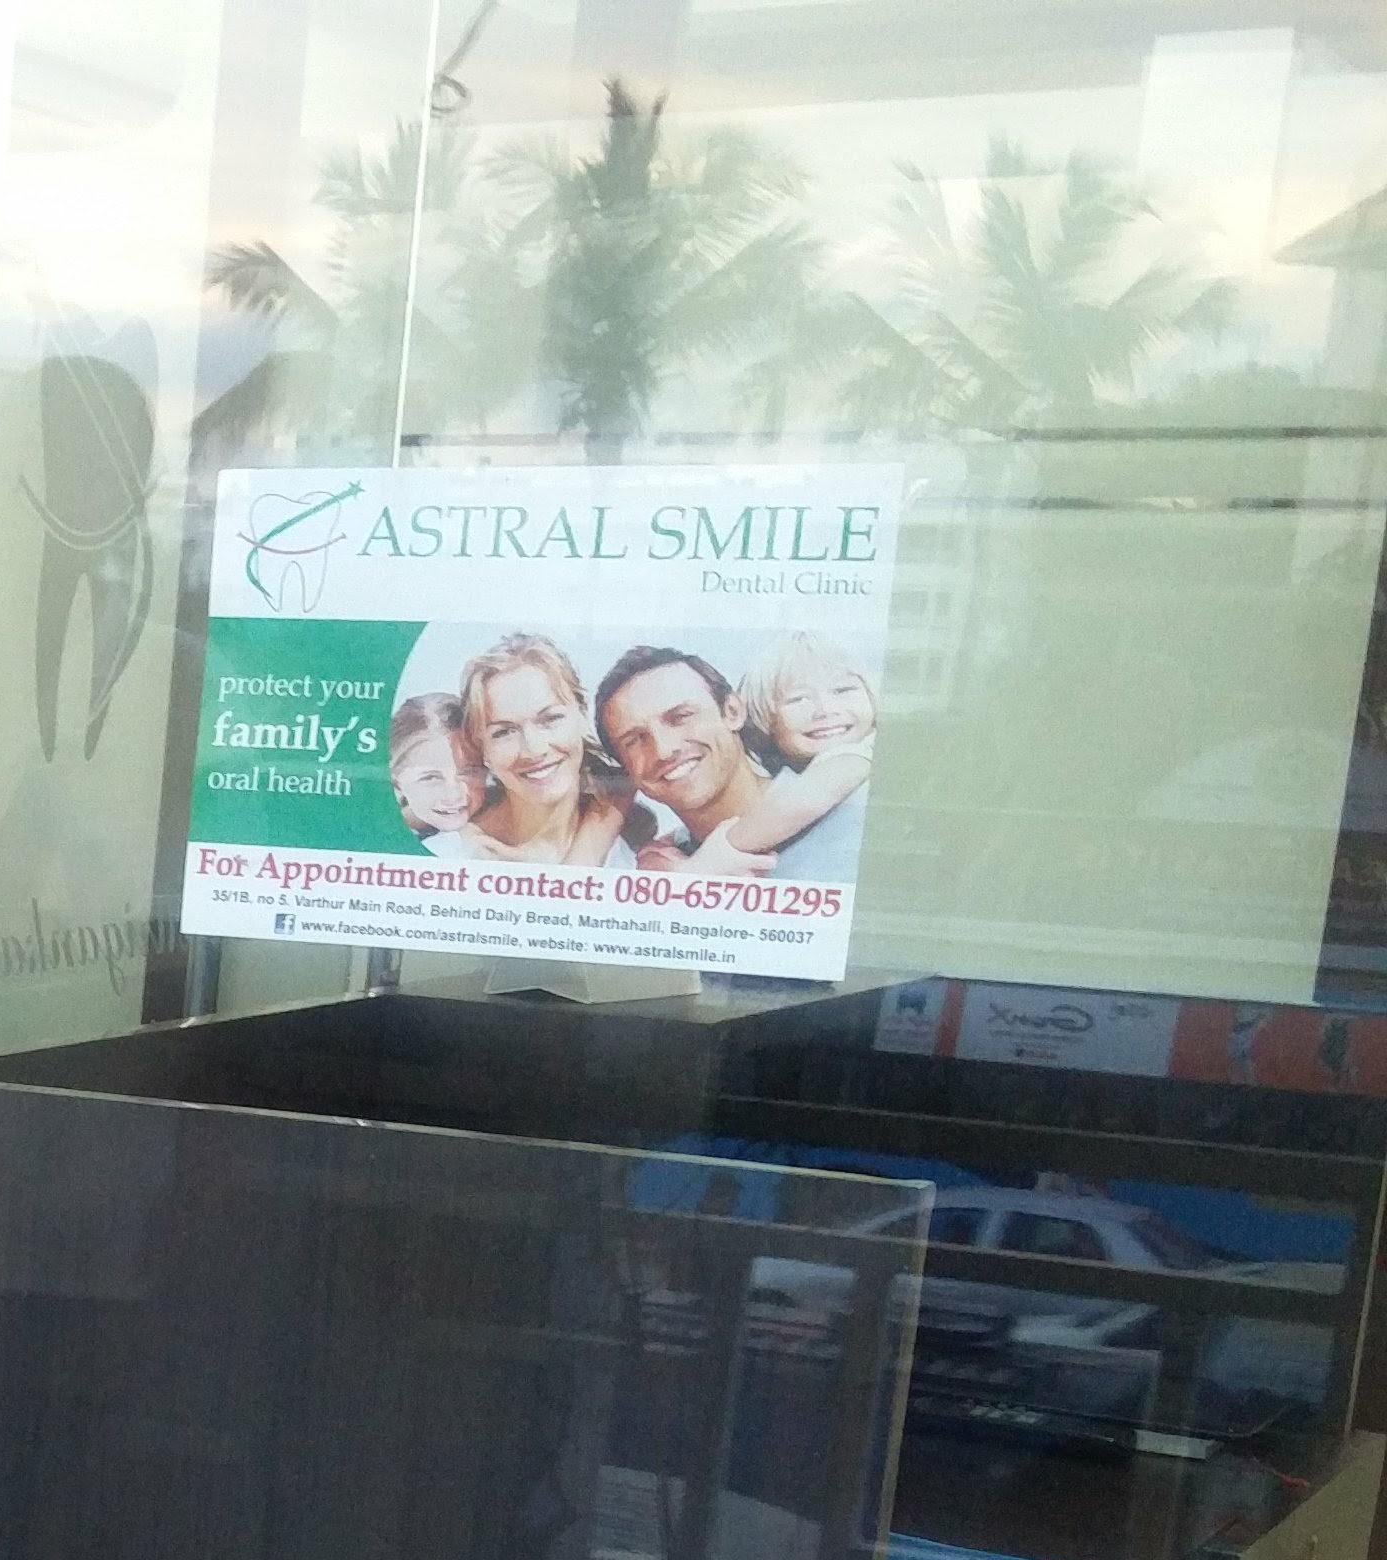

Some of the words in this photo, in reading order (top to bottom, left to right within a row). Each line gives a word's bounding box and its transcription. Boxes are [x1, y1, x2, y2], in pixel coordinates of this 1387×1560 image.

[356, 505, 629, 559] ASTRAL
[647, 506, 881, 563] SMILE
[700, 570, 785, 596] Dental
[793, 571, 874, 597] Clinic
[219, 674, 313, 703] protect
[317, 679, 386, 707] your
[211, 710, 378, 763] family's
[207, 766, 260, 792] oral
[266, 767, 352, 796] health
[196, 847, 248, 877] For
[255, 853, 470, 893] Appointment
[477, 872, 605, 902] contact:
[614, 875, 843, 918] 080-65701295
[257, 894, 275, 905] no
[294, 895, 346, 911] Varthur
[348, 898, 382, 913] Main
[385, 900, 426, 917] Road,
[430, 904, 481, 921] Behind
[485, 908, 522, 926] Daily
[526, 911, 574, 928] Bread,
[578, 915, 665, 935] Marthahalli,
[670, 922, 755, 942] Bangalore-
[759, 928, 814, 945] 560037
[301, 919, 523, 948] www.facebook.com/astralsmile,
[527, 936, 589, 953] website:
[593, 942, 736, 965] www.astralsmile.in
